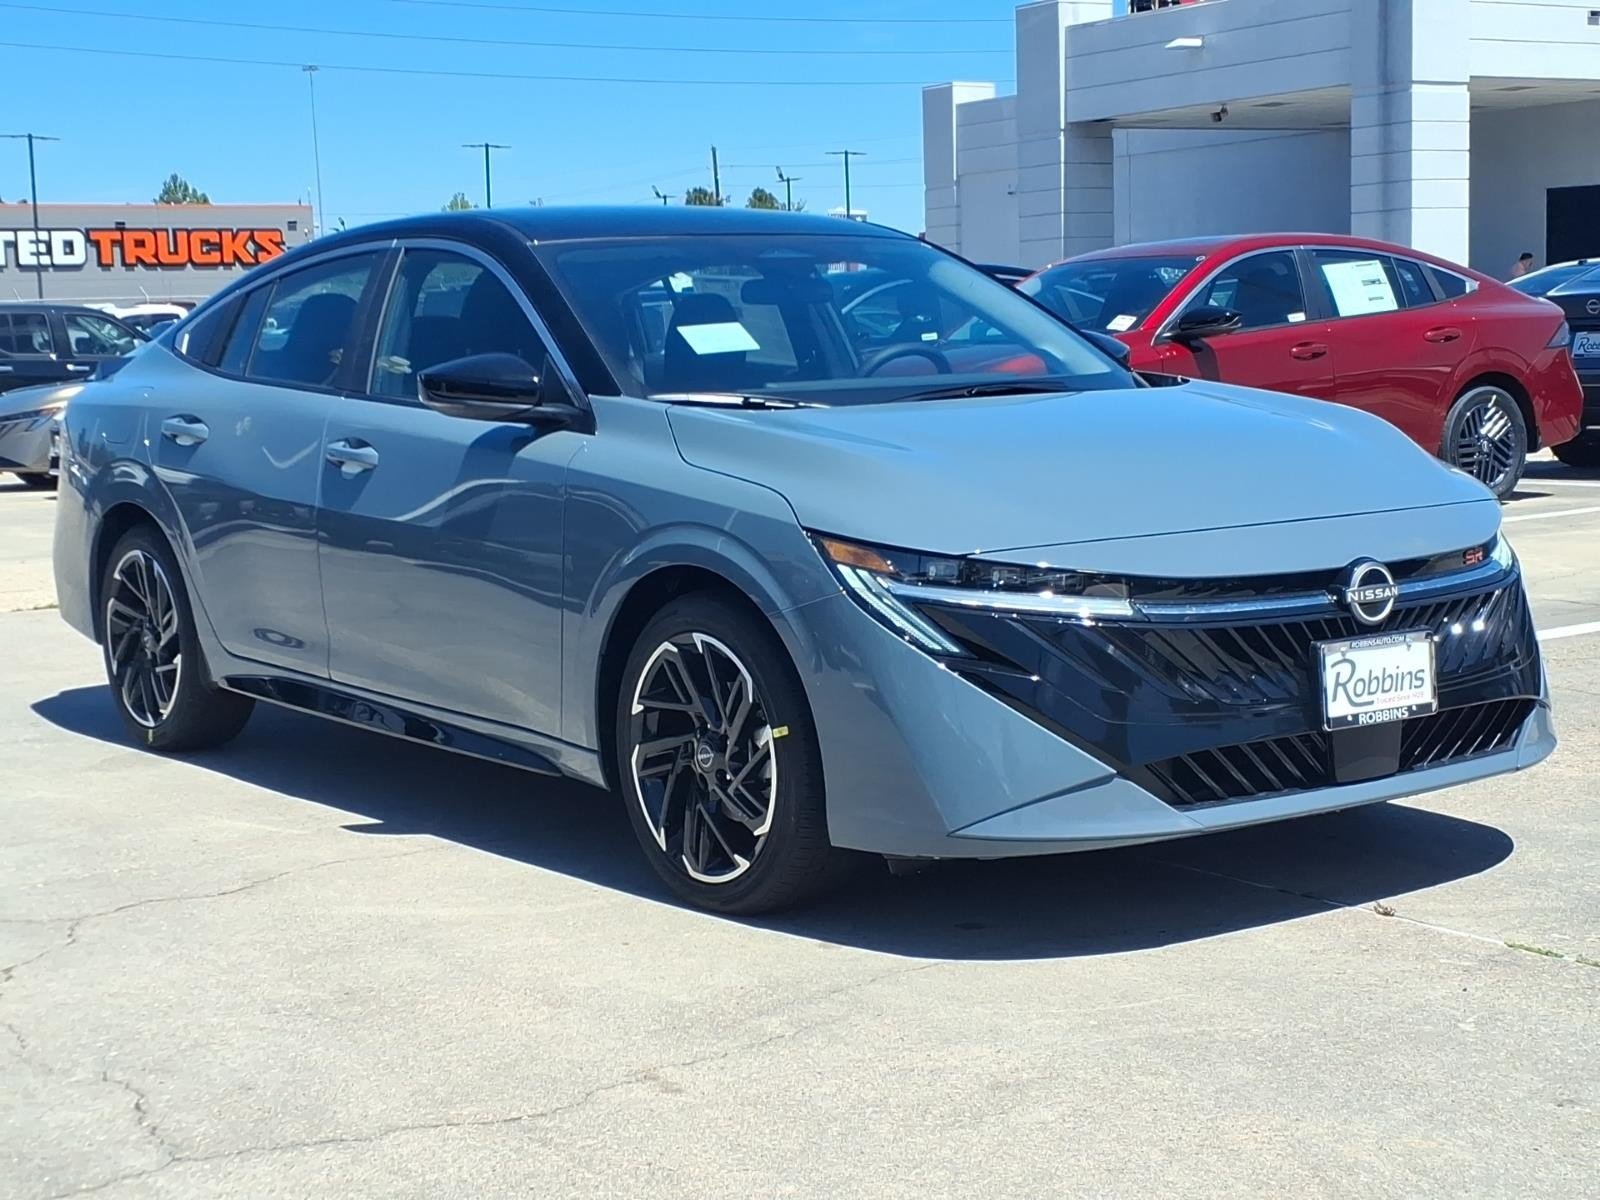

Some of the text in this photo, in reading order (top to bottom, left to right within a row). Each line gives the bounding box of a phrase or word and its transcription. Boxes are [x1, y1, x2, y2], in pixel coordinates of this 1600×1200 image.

[88, 230, 286, 266] TRUCKS
[1465, 548, 1483, 565] SR
[1347, 585, 1399, 602] NISSAN
[1330, 658, 1425, 707] Robbins
[1358, 707, 1409, 725] ROBBINS
